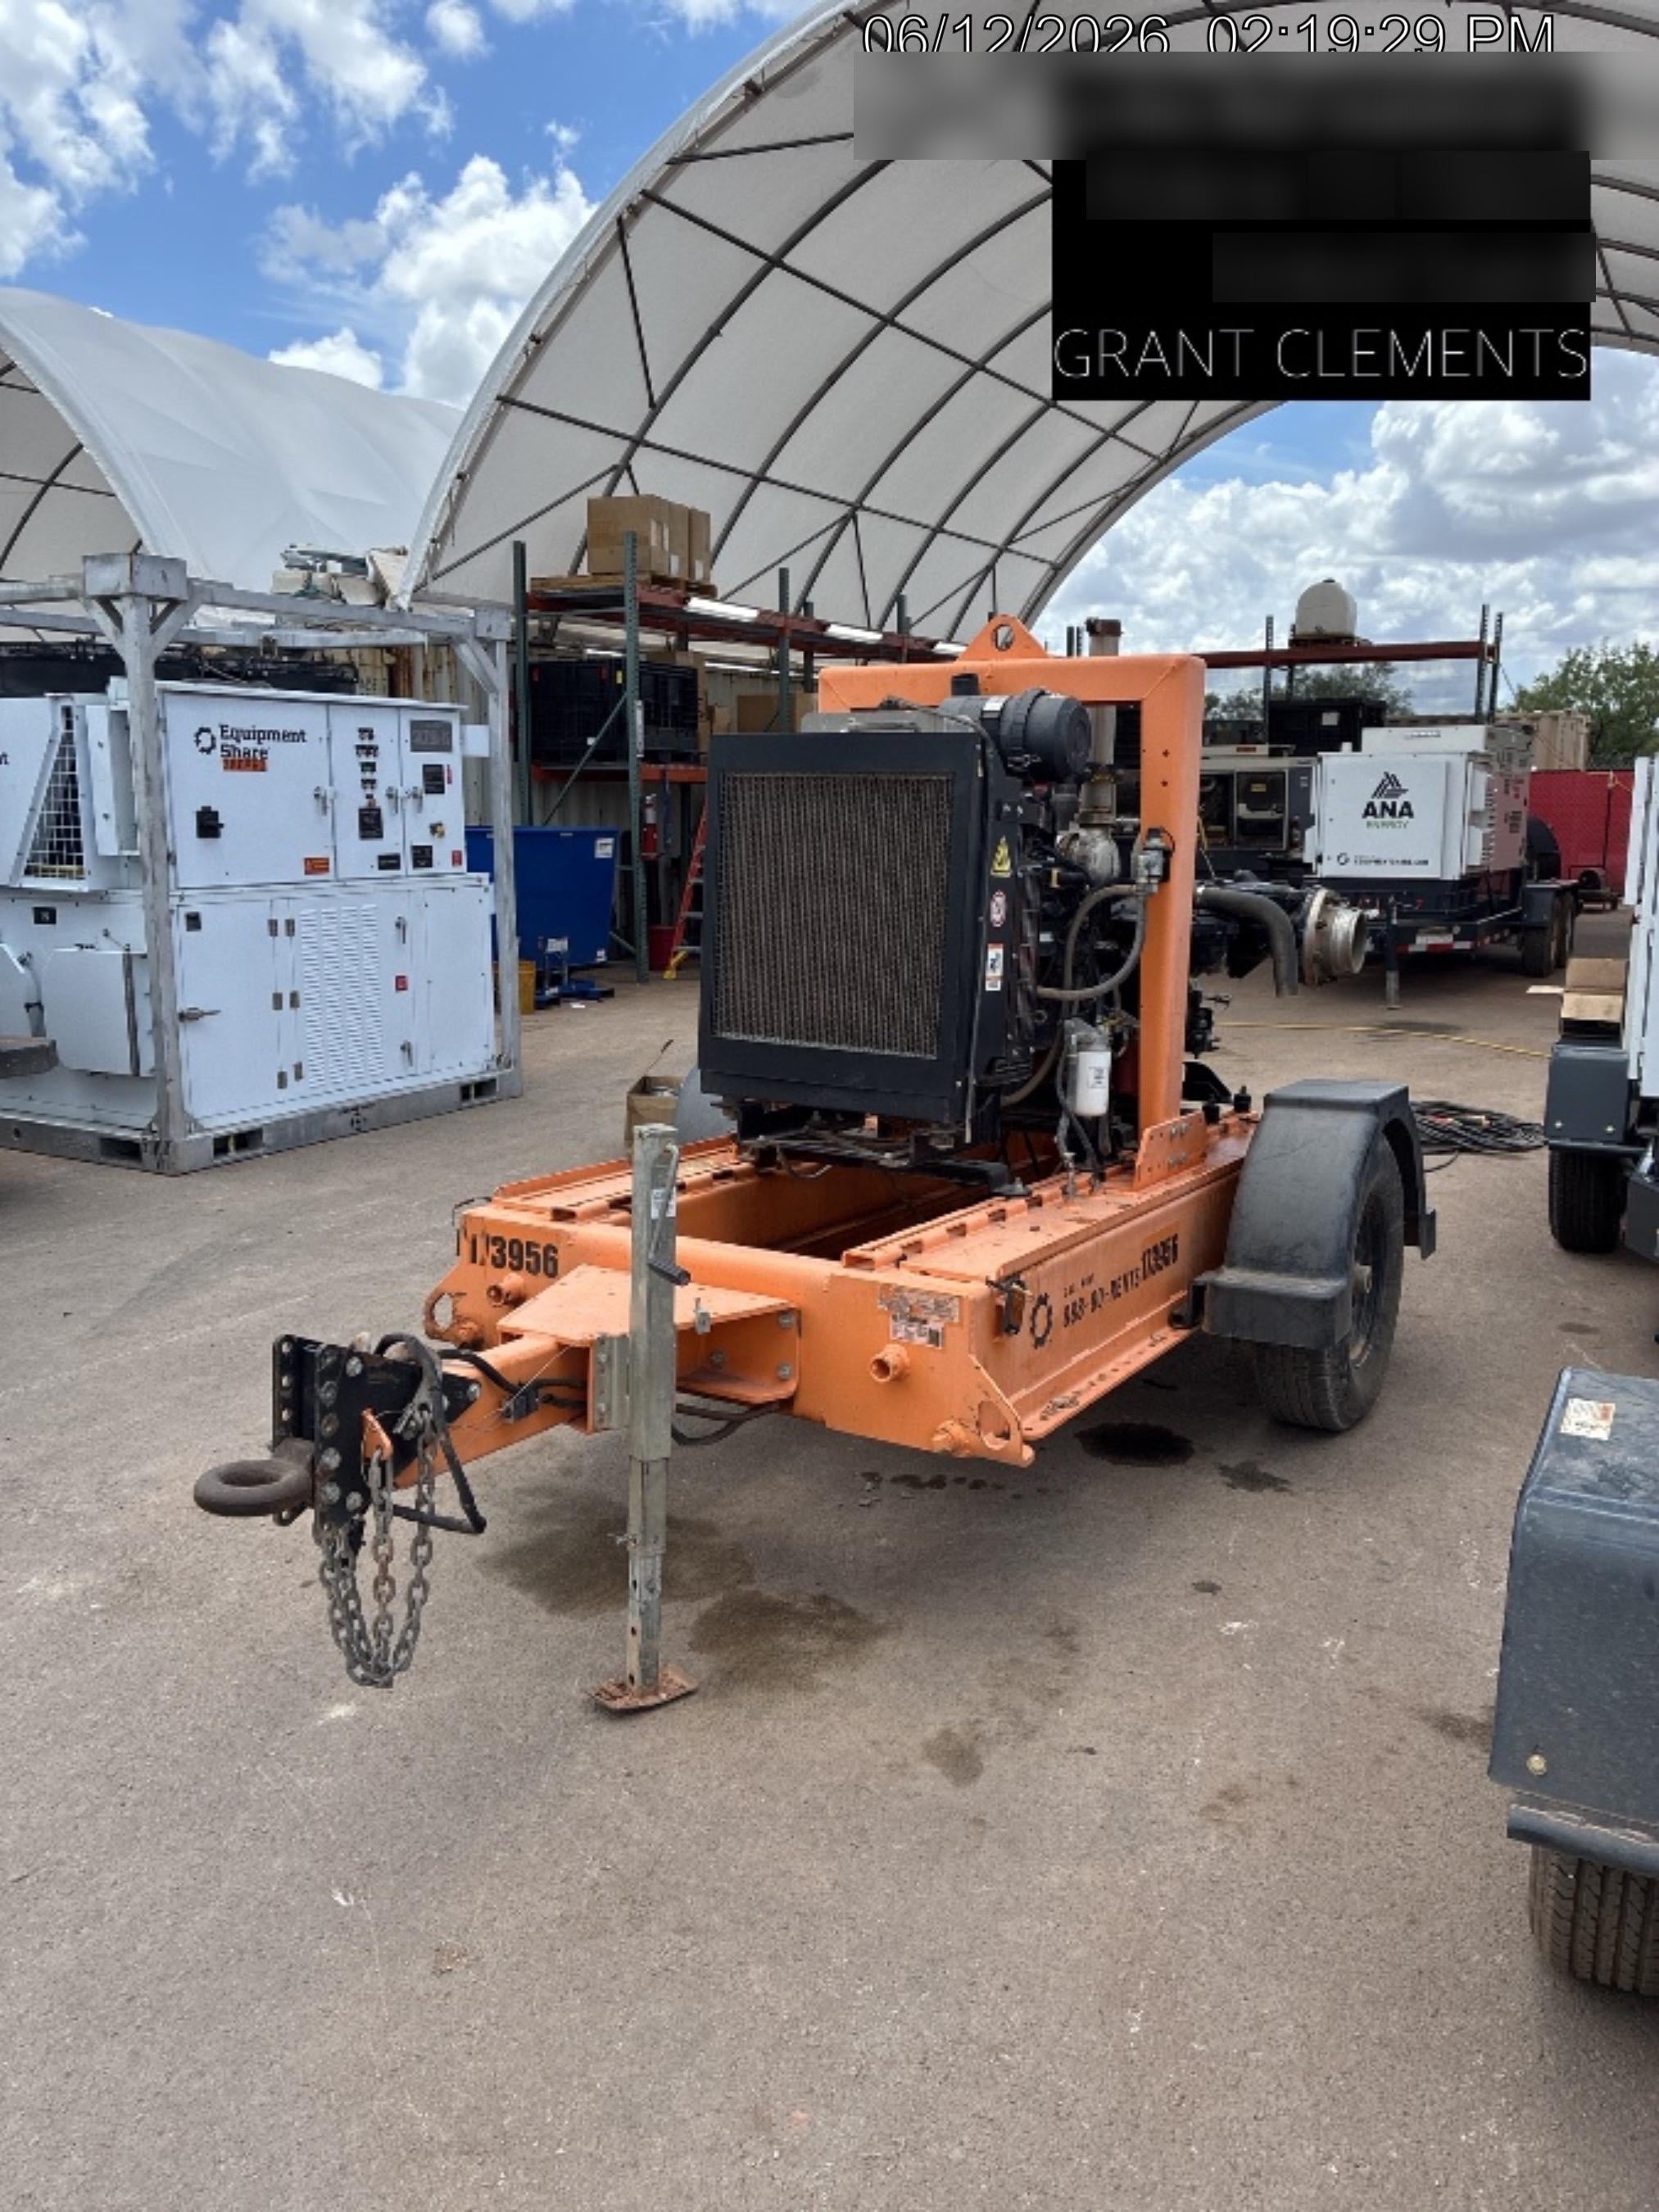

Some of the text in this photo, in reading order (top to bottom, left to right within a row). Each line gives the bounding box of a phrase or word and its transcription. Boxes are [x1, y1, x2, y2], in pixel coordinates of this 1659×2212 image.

[219, 724, 307, 745] Equipment
[220, 744, 269, 760] Share
[1362, 800, 1414, 818] ANA
